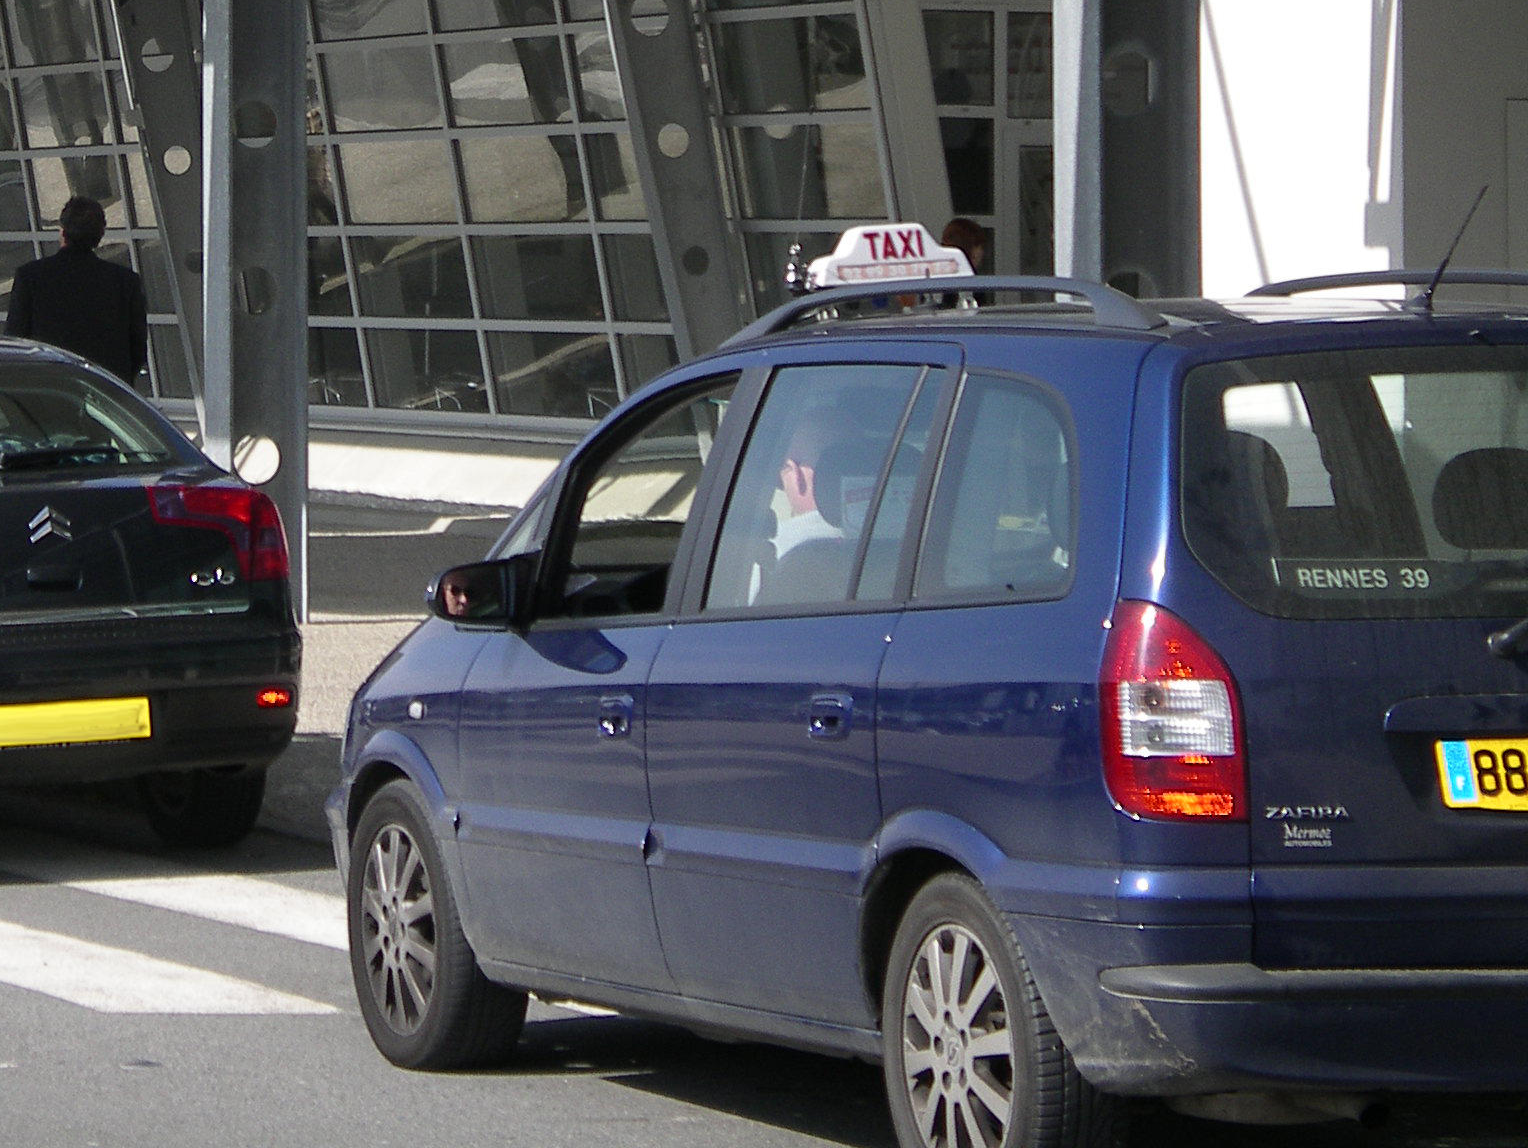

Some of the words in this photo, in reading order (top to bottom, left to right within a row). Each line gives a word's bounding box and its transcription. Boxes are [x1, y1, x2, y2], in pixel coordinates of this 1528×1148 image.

[863, 229, 925, 261] TAXI
[1297, 568, 1388, 589] RENNES
[1400, 568, 1430, 588] 39
[1265, 805, 1349, 819] ZAFIRA
